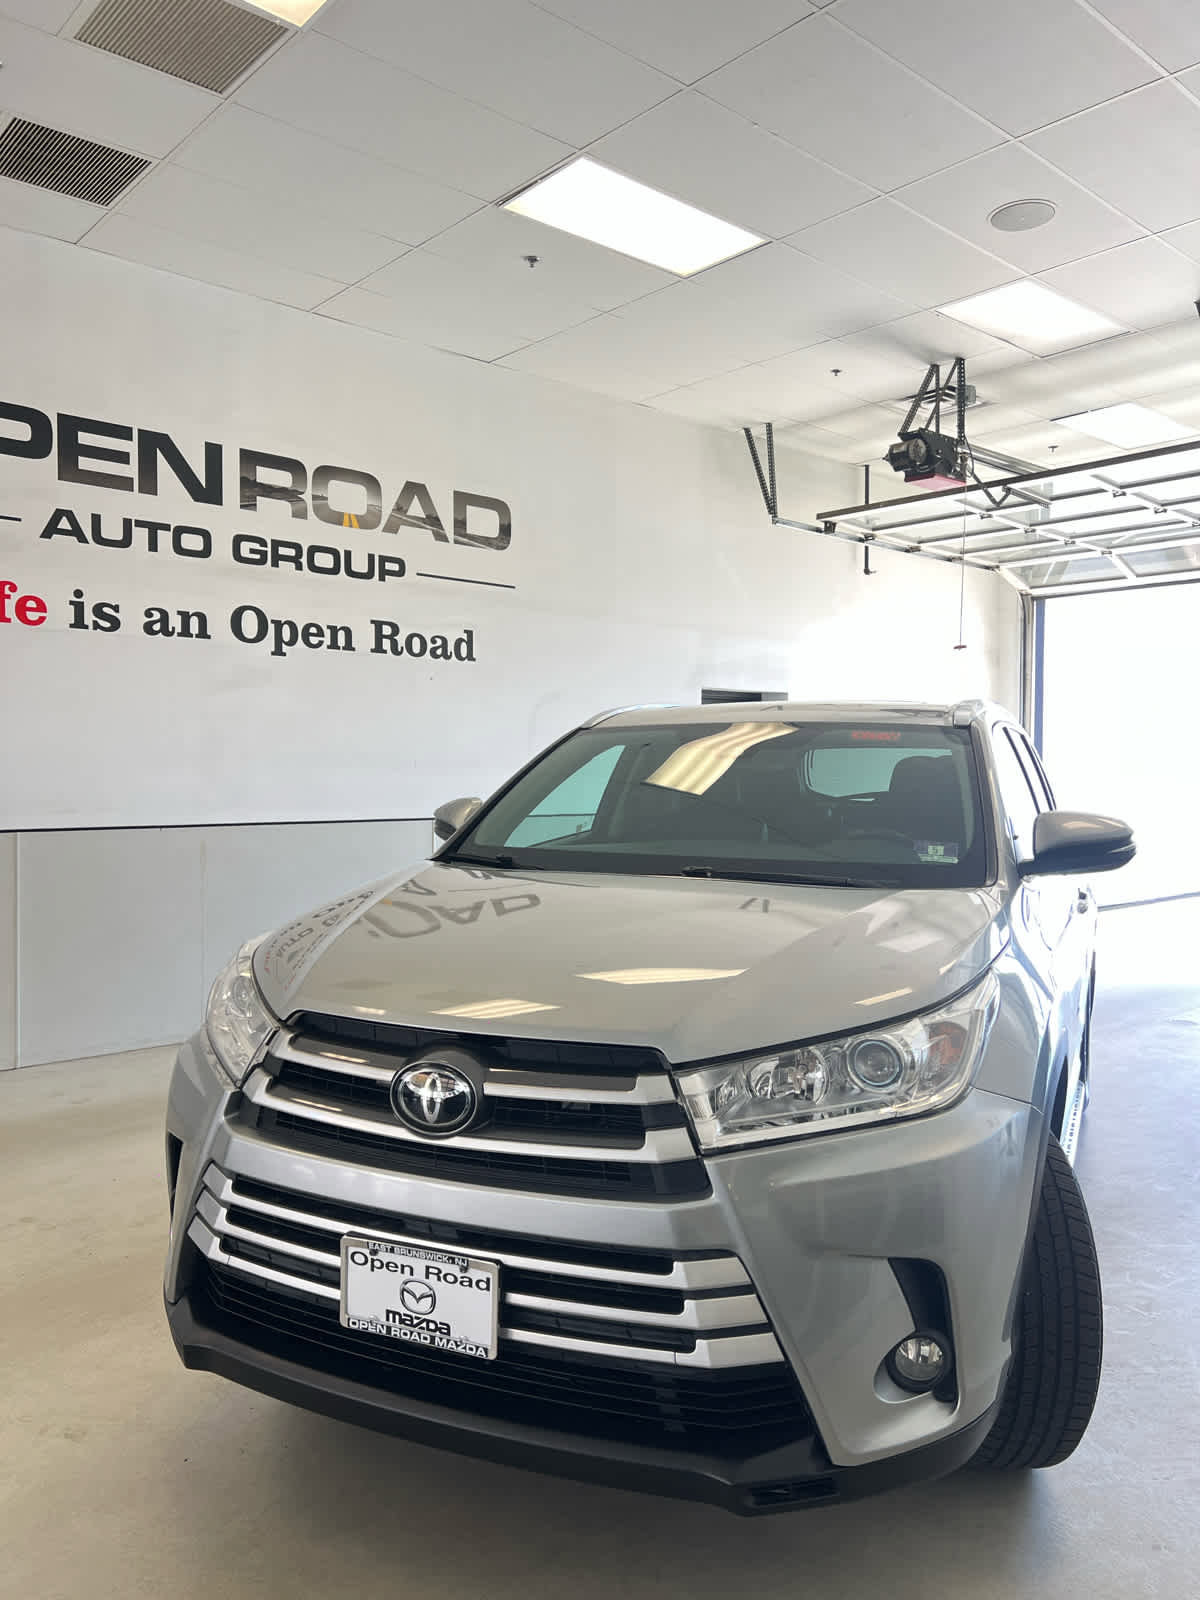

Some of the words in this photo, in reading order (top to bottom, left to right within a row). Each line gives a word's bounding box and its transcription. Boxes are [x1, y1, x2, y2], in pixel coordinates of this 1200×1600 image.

[239, 448, 512, 551] ROAD
[39, 508, 212, 559] AUTO
[232, 534, 406, 582] GROUP
[69, 589, 122, 633] is
[142, 607, 211, 640] an
[230, 605, 355, 657] Open
[370, 619, 477, 662] Road
[350, 1251, 414, 1276] Open
[425, 1265, 491, 1292] Road
[368, 1242, 393, 1255] EAST
[455, 1257, 468, 1267] NJ
[349, 1318, 386, 1335] OPEN
[391, 1328, 430, 1344] ROAD
[435, 1337, 487, 1358] MAZDA
